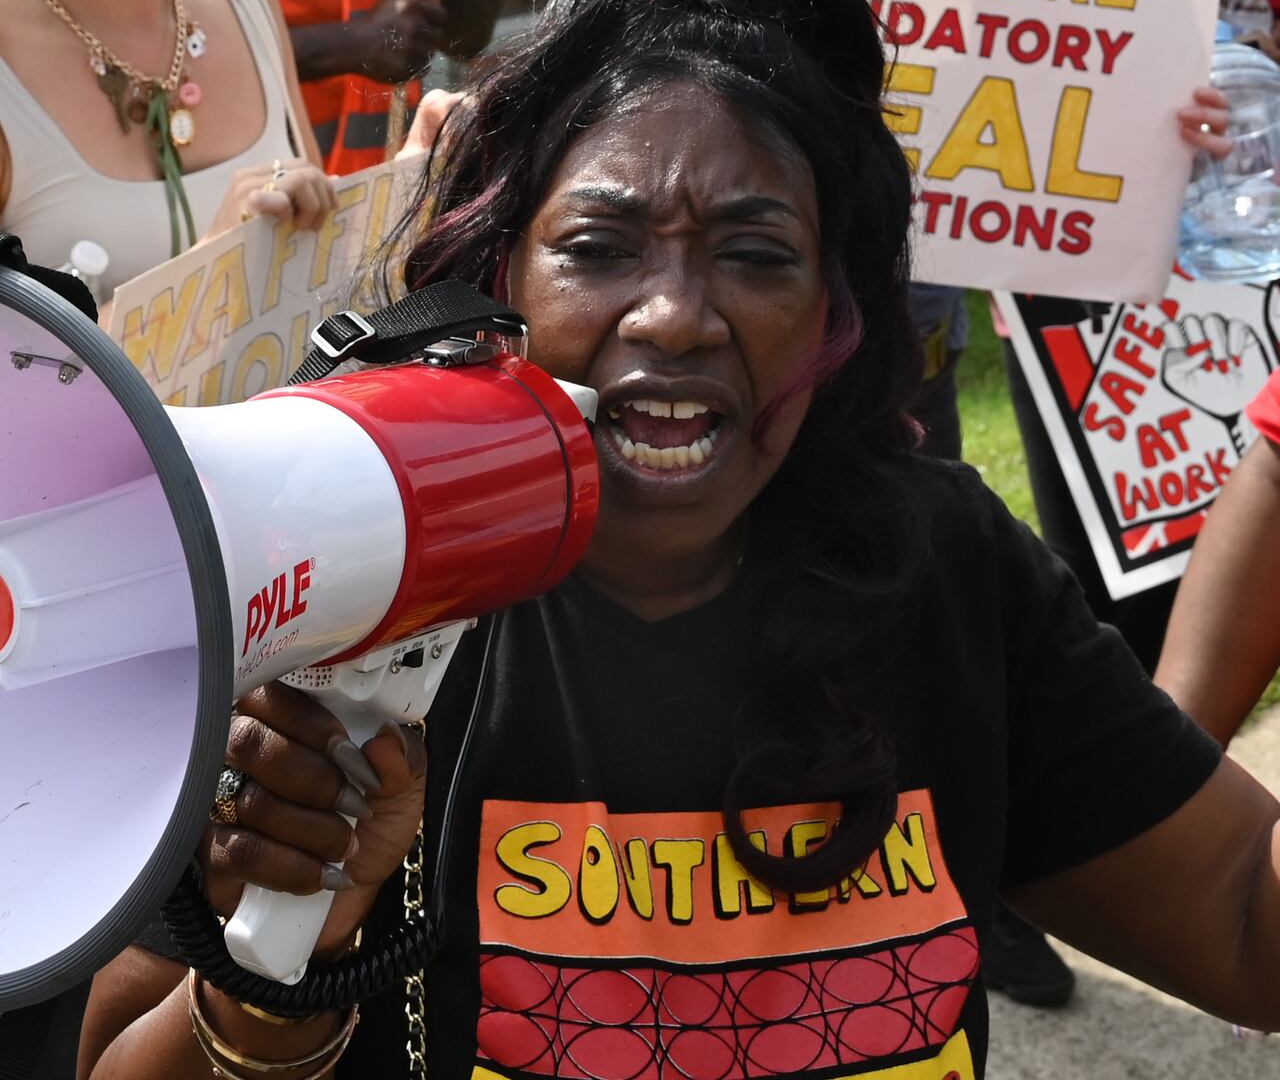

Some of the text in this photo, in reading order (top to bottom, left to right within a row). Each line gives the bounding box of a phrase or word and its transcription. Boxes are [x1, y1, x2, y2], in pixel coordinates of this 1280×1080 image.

[911, 189, 1096, 256] TIONS
[1083, 258, 1195, 442] SAFE
[1136, 408, 1192, 470] AT
[1114, 446, 1233, 521] WORK
[242, 558, 311, 658] PYLE
